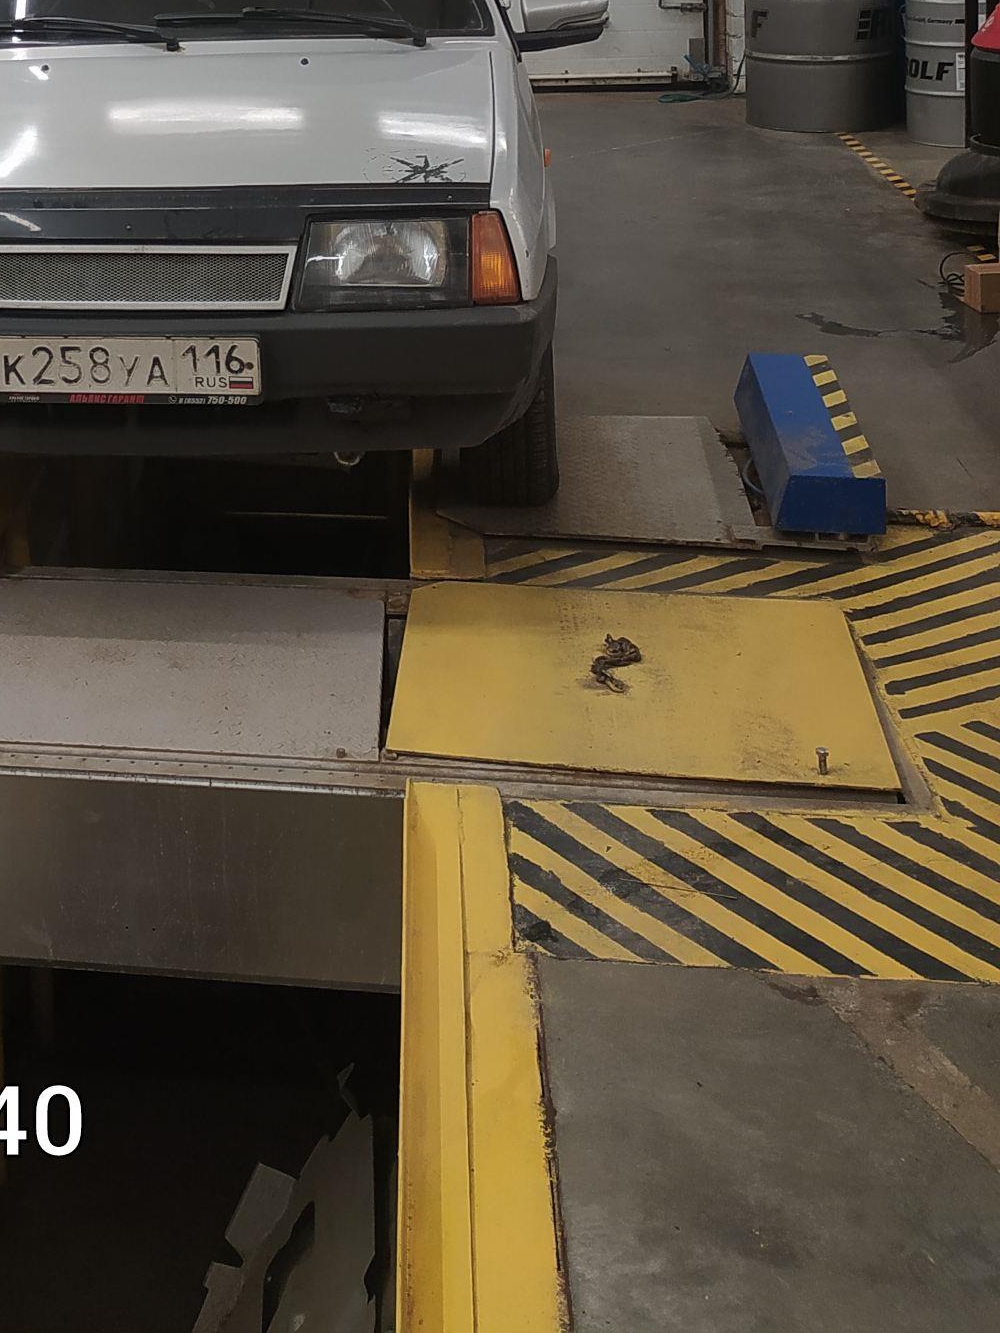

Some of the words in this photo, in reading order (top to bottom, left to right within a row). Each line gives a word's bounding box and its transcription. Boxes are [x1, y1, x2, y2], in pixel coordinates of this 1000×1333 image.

[3, 345, 169, 386] К258УА
[181, 344, 246, 375] 116
[194, 376, 227, 388] RUS
